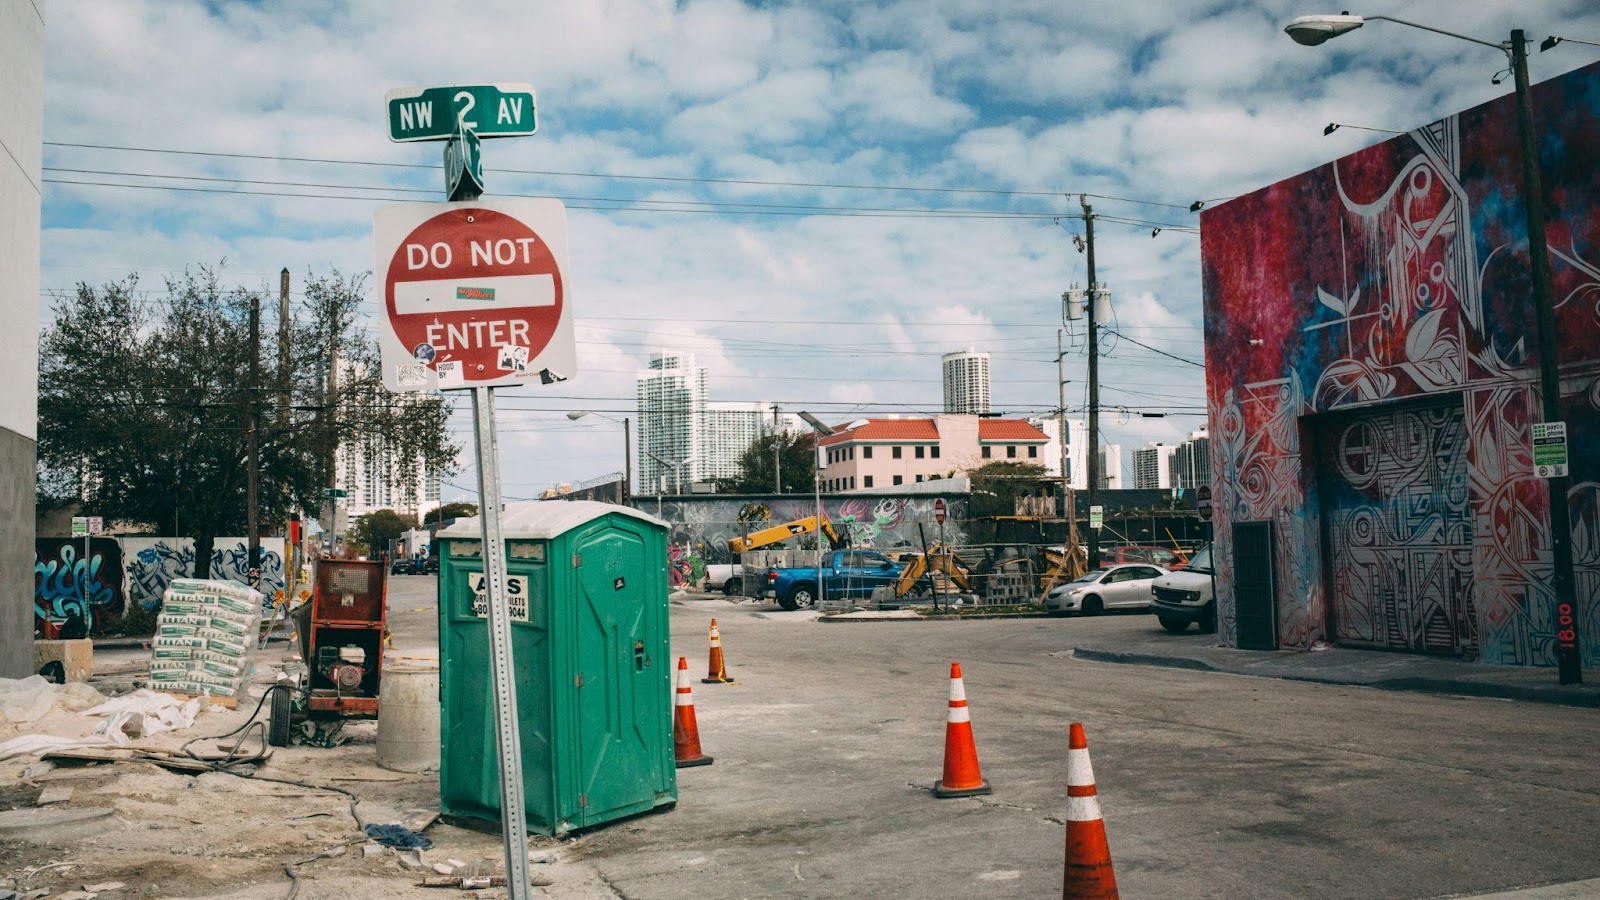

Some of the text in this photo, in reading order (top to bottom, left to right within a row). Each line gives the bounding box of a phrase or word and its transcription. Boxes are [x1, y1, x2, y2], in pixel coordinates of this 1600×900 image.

[400, 91, 522, 130] NW 2 AV
[407, 238, 535, 270] DO NOT
[426, 319, 531, 350] ENTER
[438, 363, 454, 371] HOOD
[438, 371, 447, 379] BY
[170, 594, 206, 603] TITAN
[162, 616, 198, 625] TITAN
[157, 639, 193, 647] TITAN
